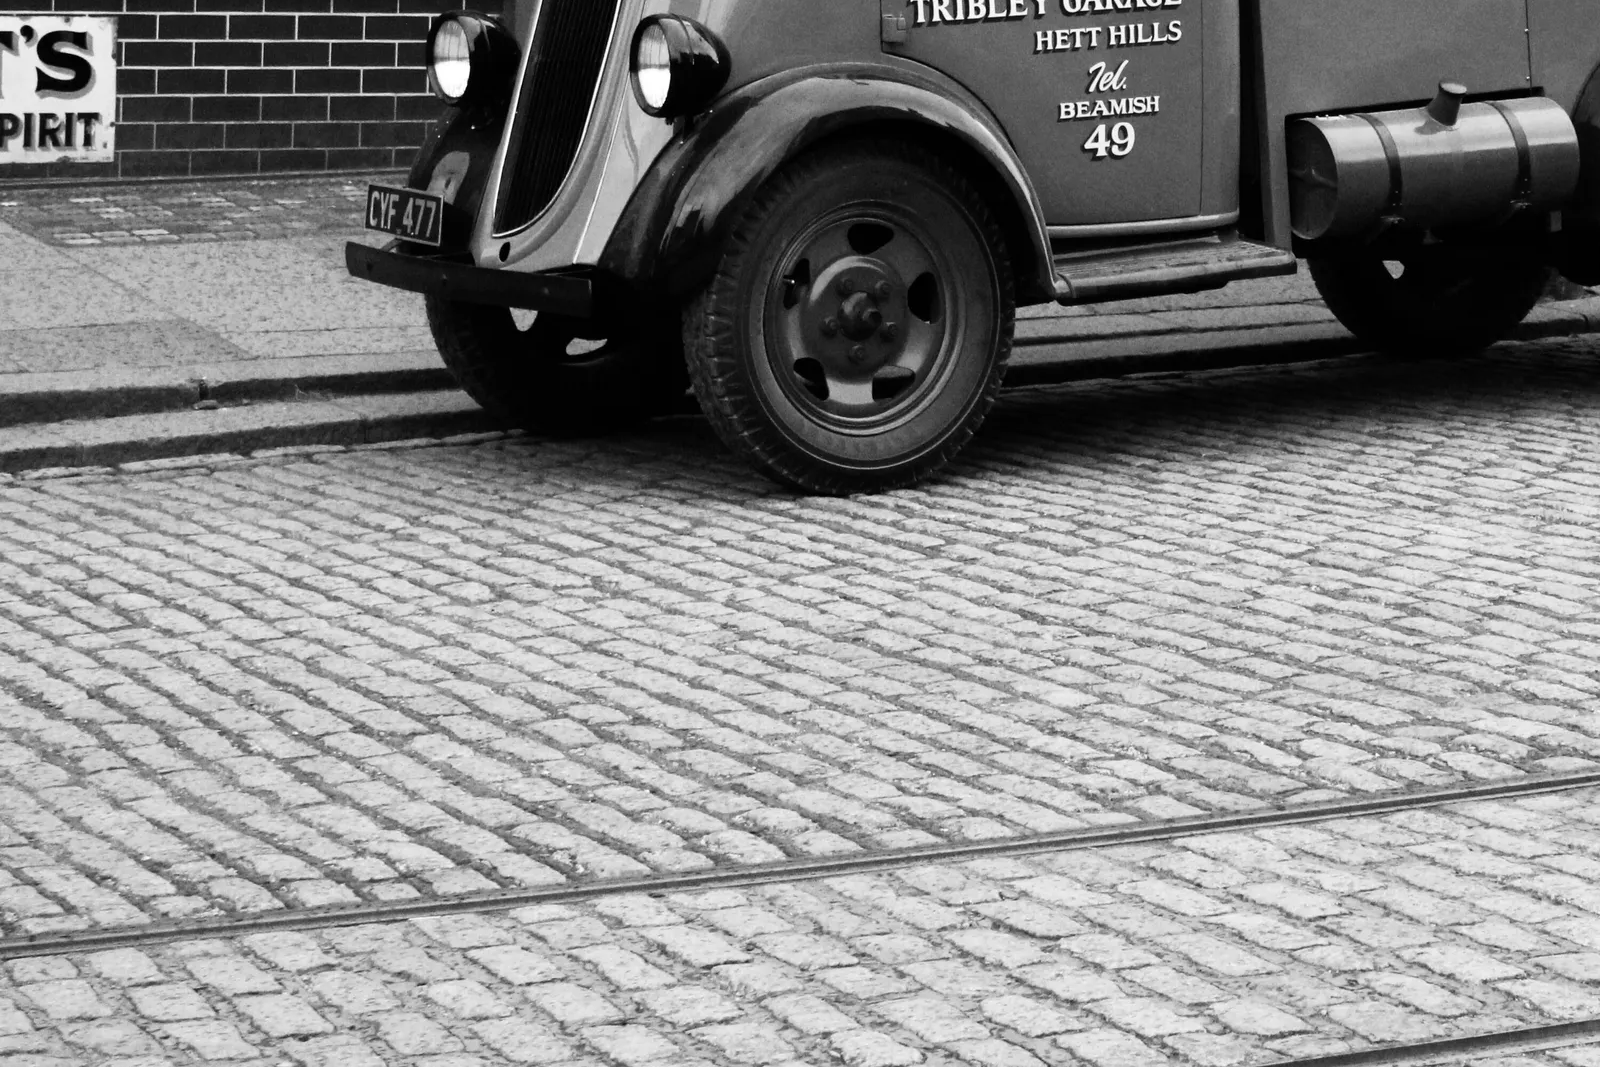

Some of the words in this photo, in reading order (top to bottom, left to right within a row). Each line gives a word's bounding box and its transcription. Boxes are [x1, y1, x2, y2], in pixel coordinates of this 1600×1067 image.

[1033, 26, 1102, 53] HETT
[1107, 20, 1182, 47] HILLS
[1086, 59, 1129, 94] Tel.
[1057, 96, 1160, 122] BEAMISH
[1082, 122, 1136, 159] 49
[369, 190, 400, 230] CYF
[402, 197, 437, 238] 477
